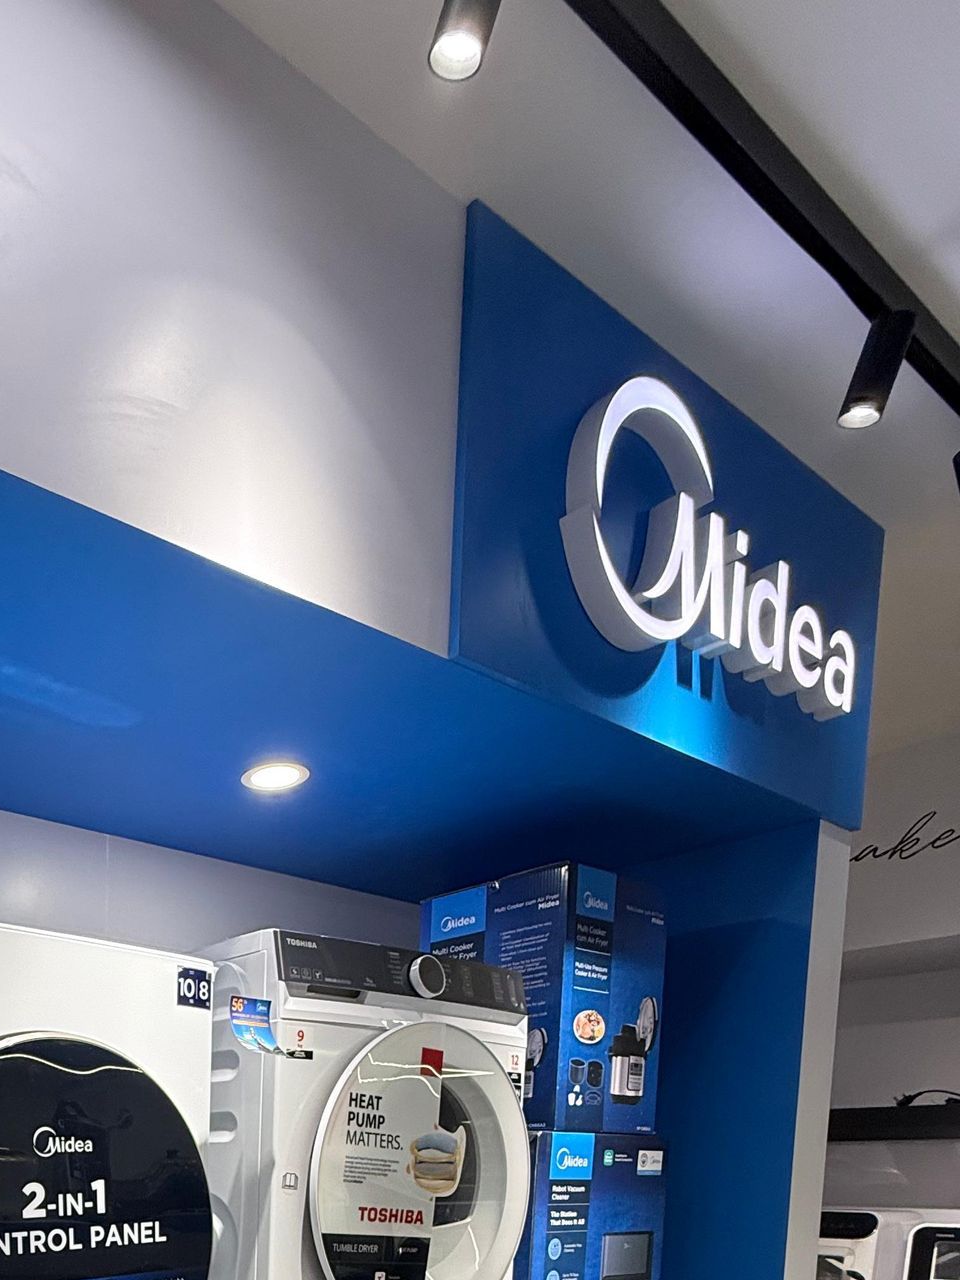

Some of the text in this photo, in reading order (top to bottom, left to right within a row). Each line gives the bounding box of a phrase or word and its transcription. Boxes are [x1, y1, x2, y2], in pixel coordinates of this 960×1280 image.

[593, 376, 855, 713] Midea
[538, 900, 560, 911] Midea
[583, 891, 609, 911] Midea
[441, 915, 476, 932] Midea
[286, 937, 318, 949] TOSHIBA
[432, 942, 474, 955] Multi Cooker
[178, 977, 209, 1000] 10 8
[297, 1030, 305, 1042] 9
[511, 1054, 519, 1066] 12
[348, 1092, 382, 1111] HEAT
[347, 1111, 385, 1130] PUMP
[33, 1126, 93, 1157] Midea
[345, 1129, 403, 1151] MATTERS.
[556, 1147, 588, 1170] Midea
[551, 1193, 570, 1201] Cleaner
[552, 1185, 586, 1193] Robot Vacuum
[21, 1179, 106, 1219] 2-IN-1
[358, 1206, 424, 1225] TOSHIBA
[91, 1221, 167, 1248] PANEL
[333, 1243, 379, 1253] TUMBLE DRYER
